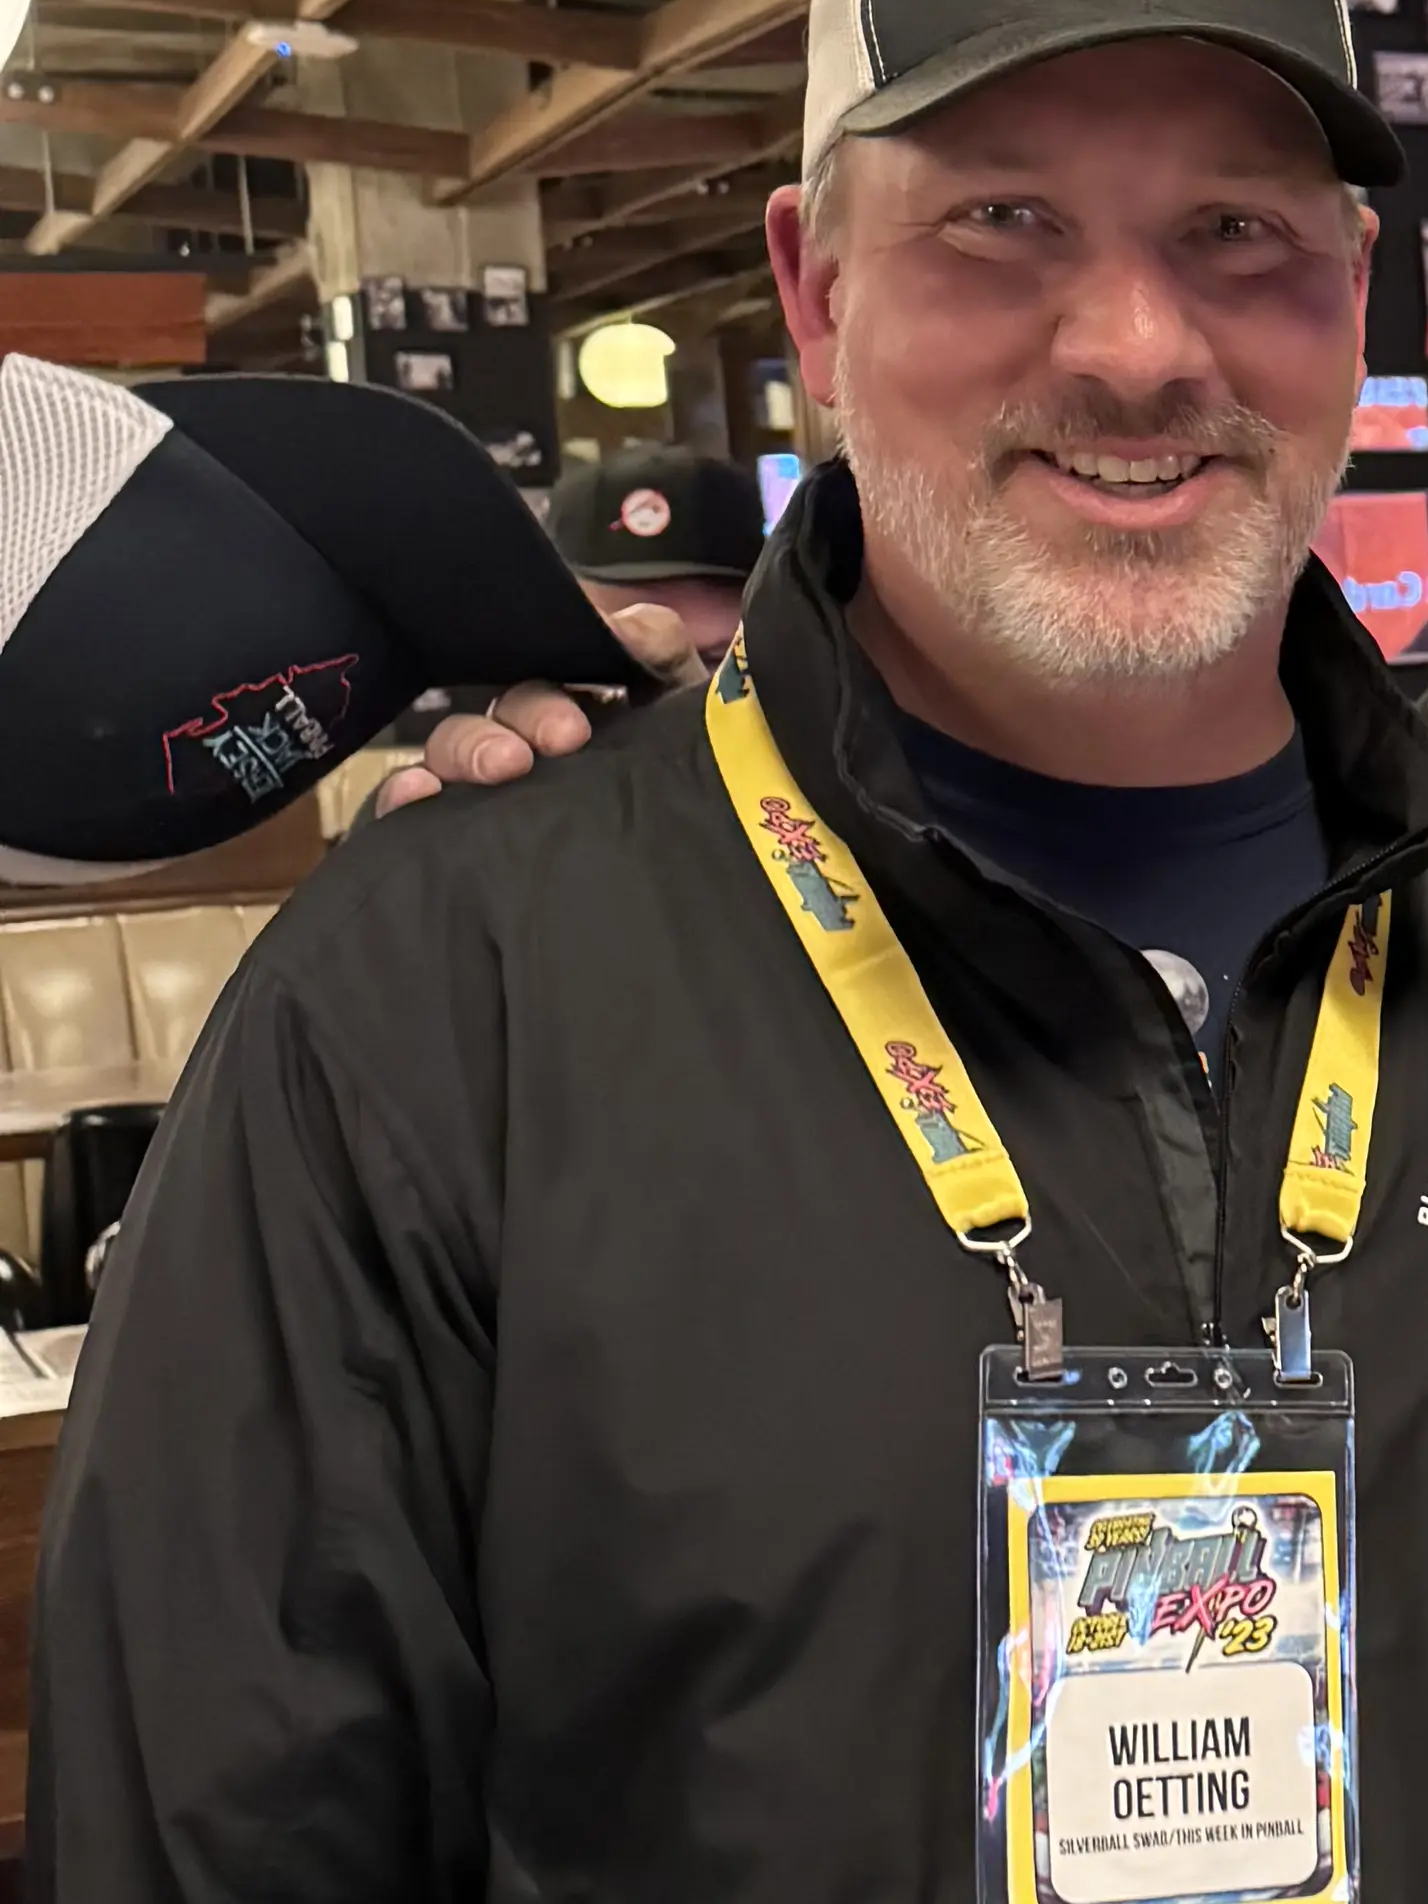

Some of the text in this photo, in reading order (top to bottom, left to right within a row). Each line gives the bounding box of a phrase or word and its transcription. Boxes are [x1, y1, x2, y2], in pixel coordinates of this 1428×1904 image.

[1078, 1527, 1266, 1611] PINBALL
[1150, 1573, 1277, 1640] EXPO
[1219, 1615, 1278, 1657] '23
[1109, 1716, 1251, 1766] WILLIAM
[1113, 1769, 1250, 1820] OETTING
[1205, 1823, 1238, 1842] WEEK
[1241, 1822, 1253, 1839] IN
[1255, 1818, 1304, 1838] PINBALL
